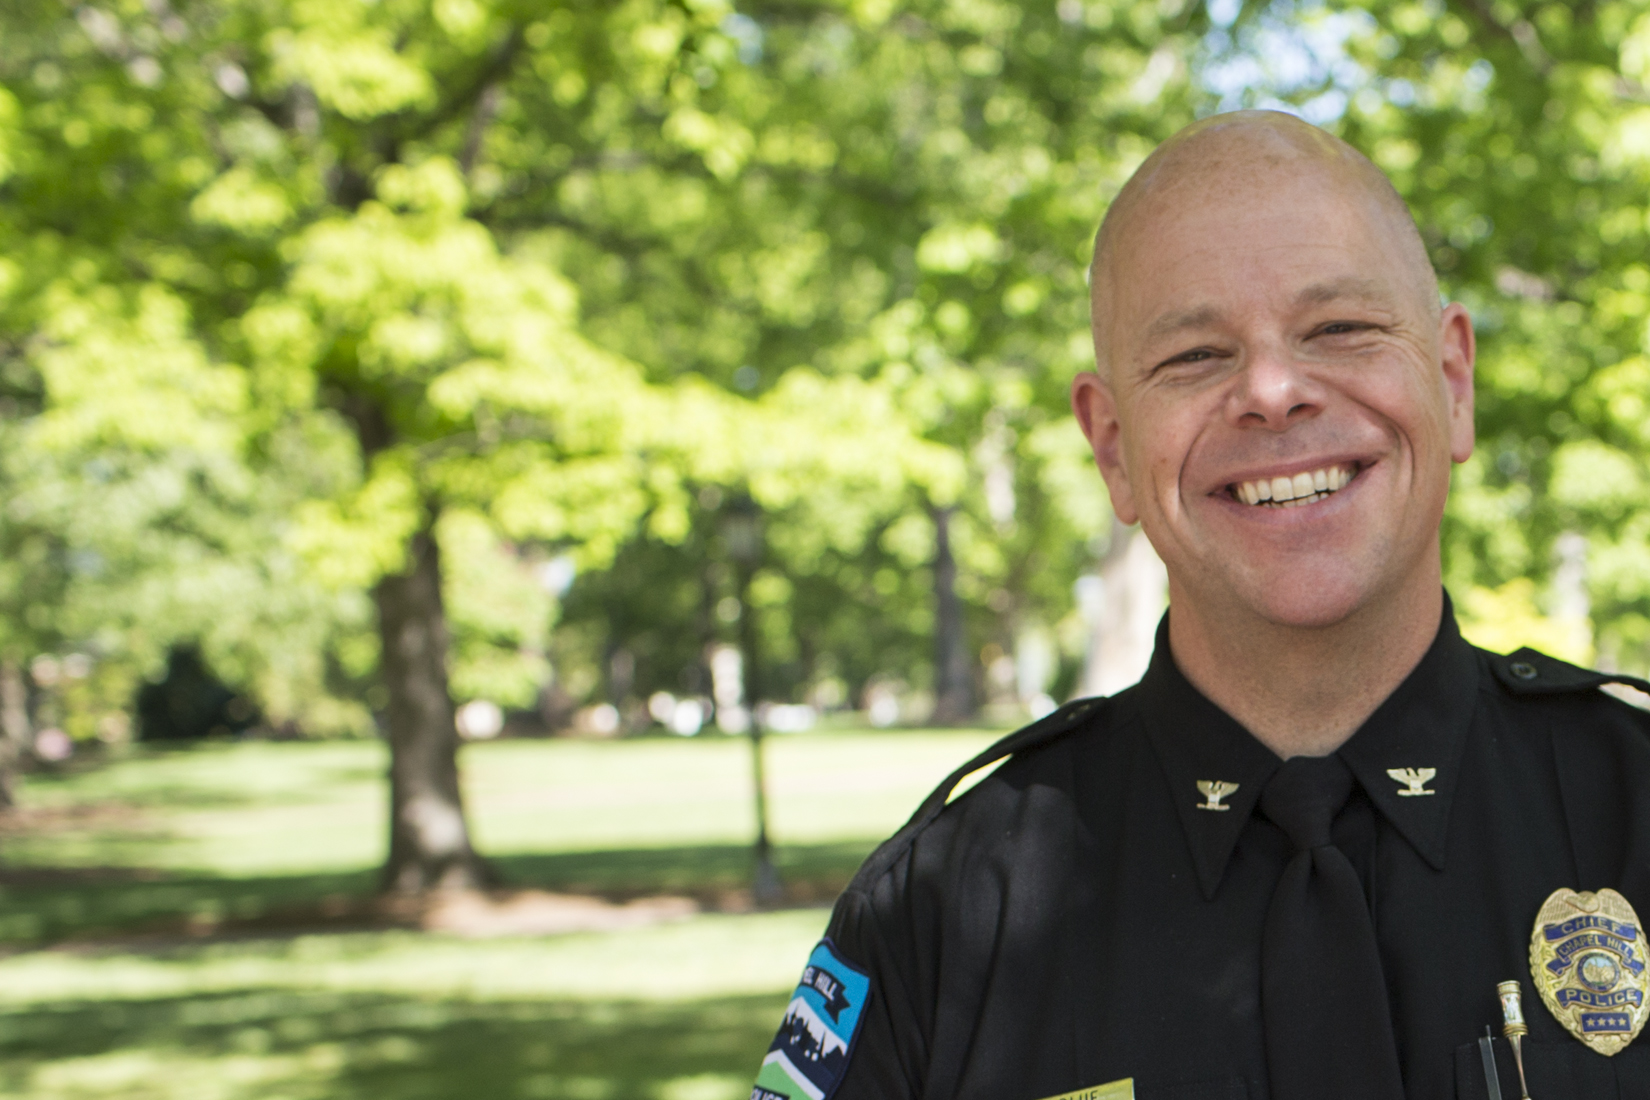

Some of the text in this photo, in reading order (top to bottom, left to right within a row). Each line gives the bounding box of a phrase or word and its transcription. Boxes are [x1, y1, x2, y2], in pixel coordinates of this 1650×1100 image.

[1561, 917, 1621, 934] CHIEF
[1558, 935, 1632, 958] CHAPEL HILL
[814, 971, 838, 1001] HILL
[1565, 989, 1637, 1006] POLICE
